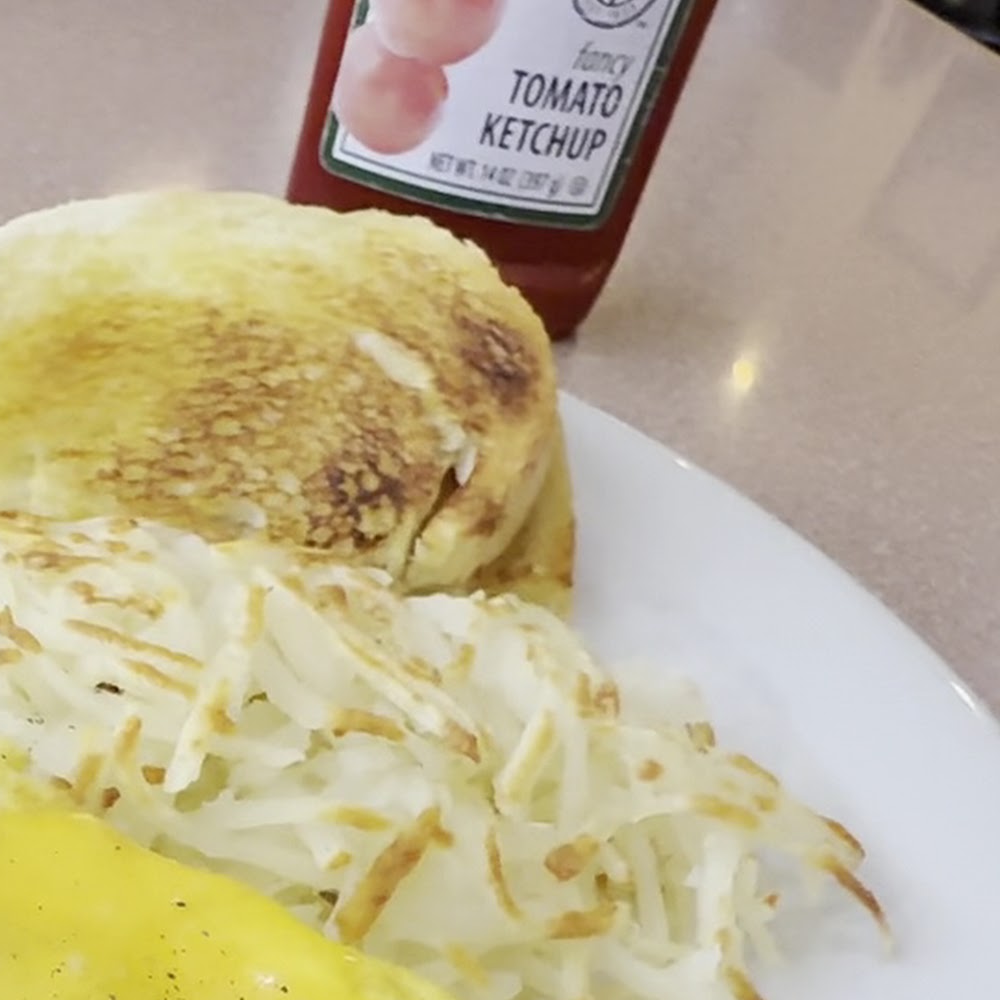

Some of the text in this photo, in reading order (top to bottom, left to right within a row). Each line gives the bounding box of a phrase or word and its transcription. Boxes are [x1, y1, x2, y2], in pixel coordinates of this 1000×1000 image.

[571, 41, 636, 79] fancy
[509, 70, 623, 119] TOMATO
[479, 112, 608, 161] KETCHUP
